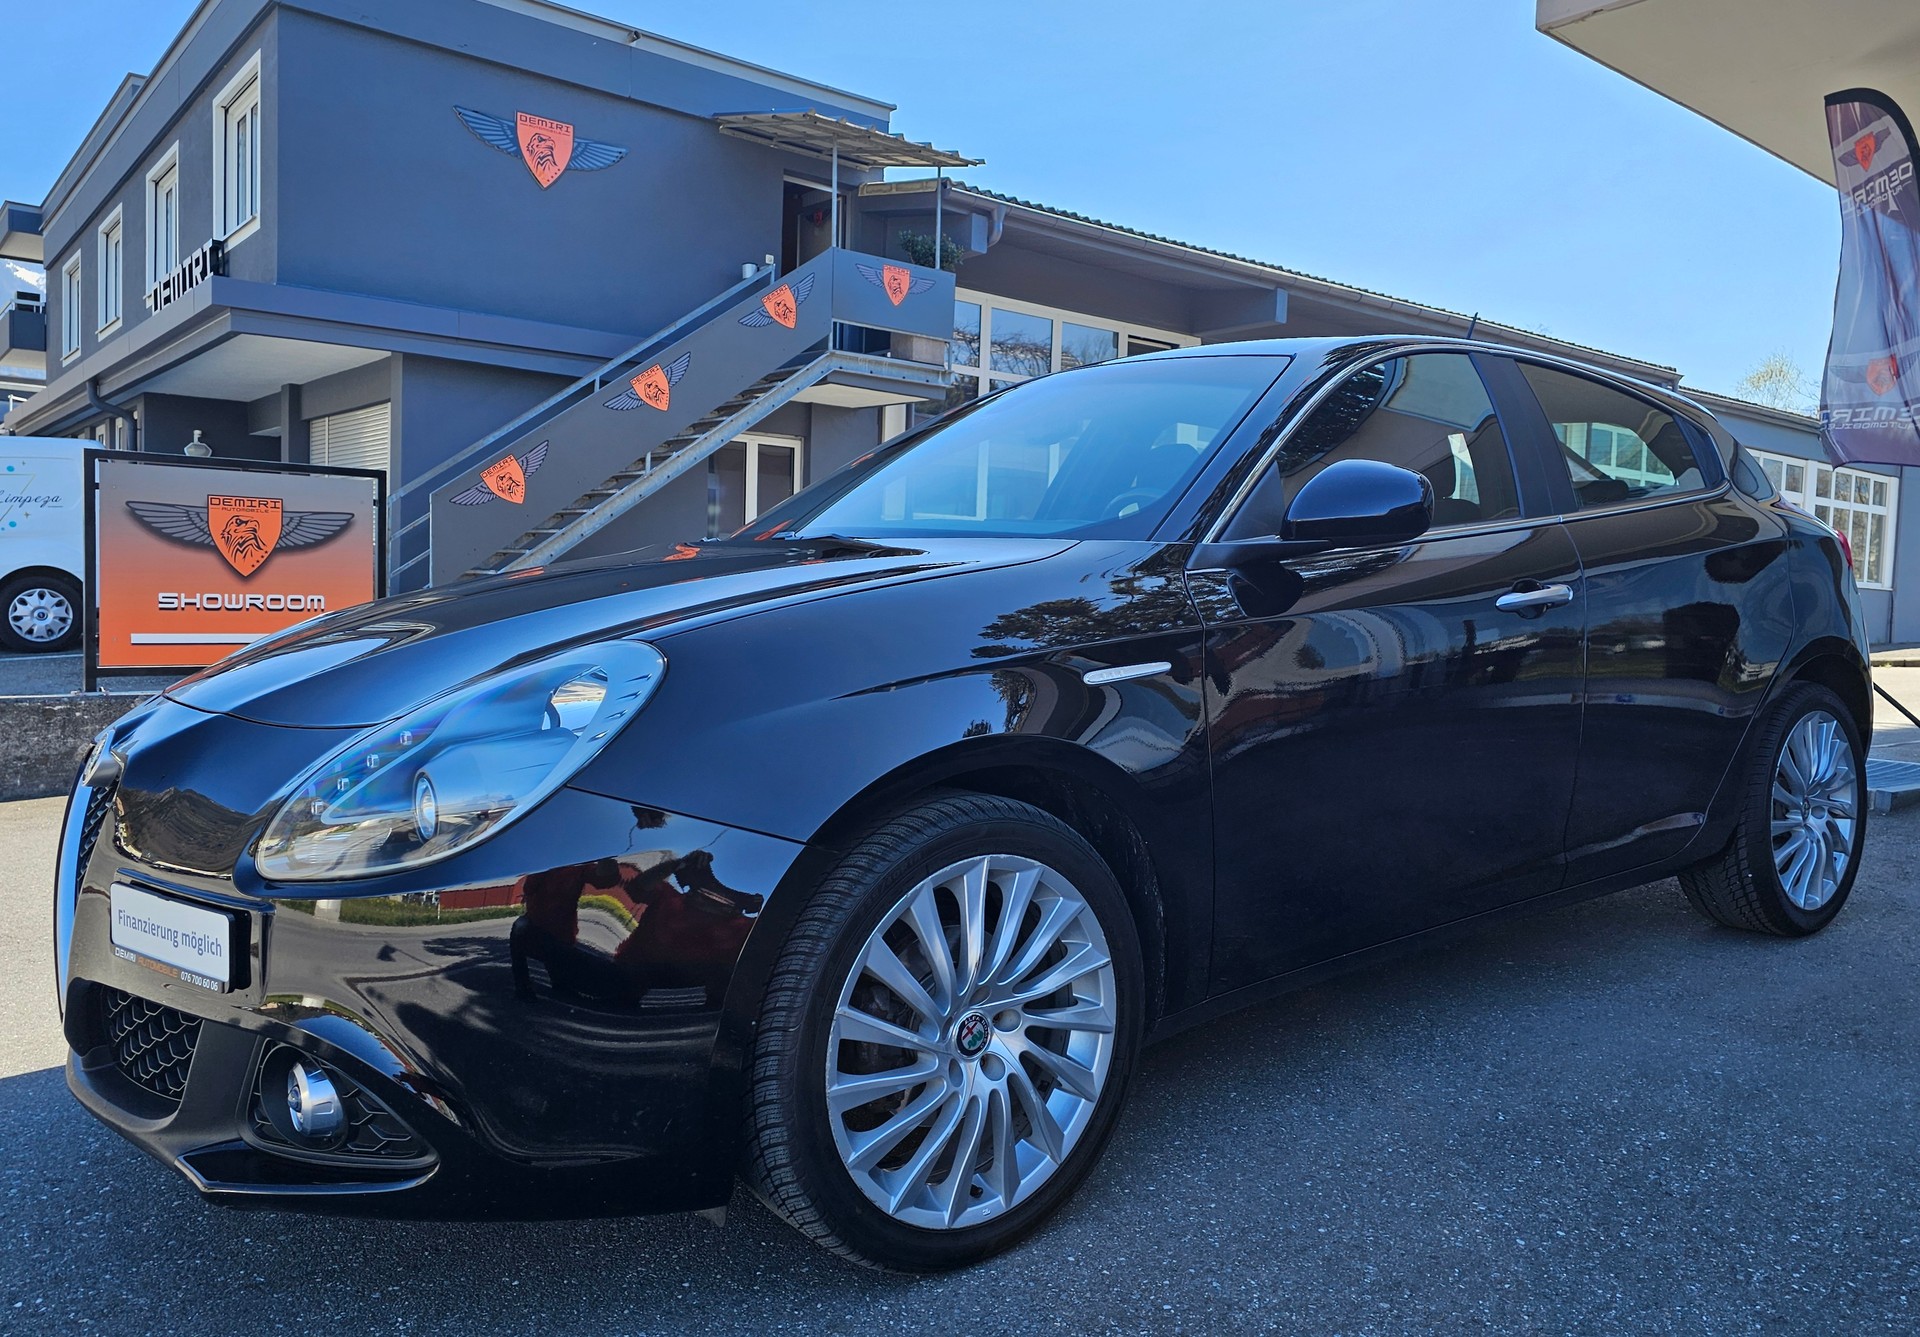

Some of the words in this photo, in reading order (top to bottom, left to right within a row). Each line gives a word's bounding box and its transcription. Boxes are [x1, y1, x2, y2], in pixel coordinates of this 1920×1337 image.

[519, 114, 571, 133] DEMIRI
[152, 238, 214, 316] DEMIRI
[481, 456, 513, 479] DEMIRI
[209, 497, 281, 509] DEMIRI
[158, 592, 325, 611] SHOWROOM
[118, 909, 179, 948] Finanzierung
[181, 931, 222, 957] möglich
[138, 957, 178, 978] AUTOMOBILE
[181, 971, 191, 983] 076
[192, 975, 202, 986] 700
[203, 979, 210, 989] 60
[210, 982, 219, 992] 06
